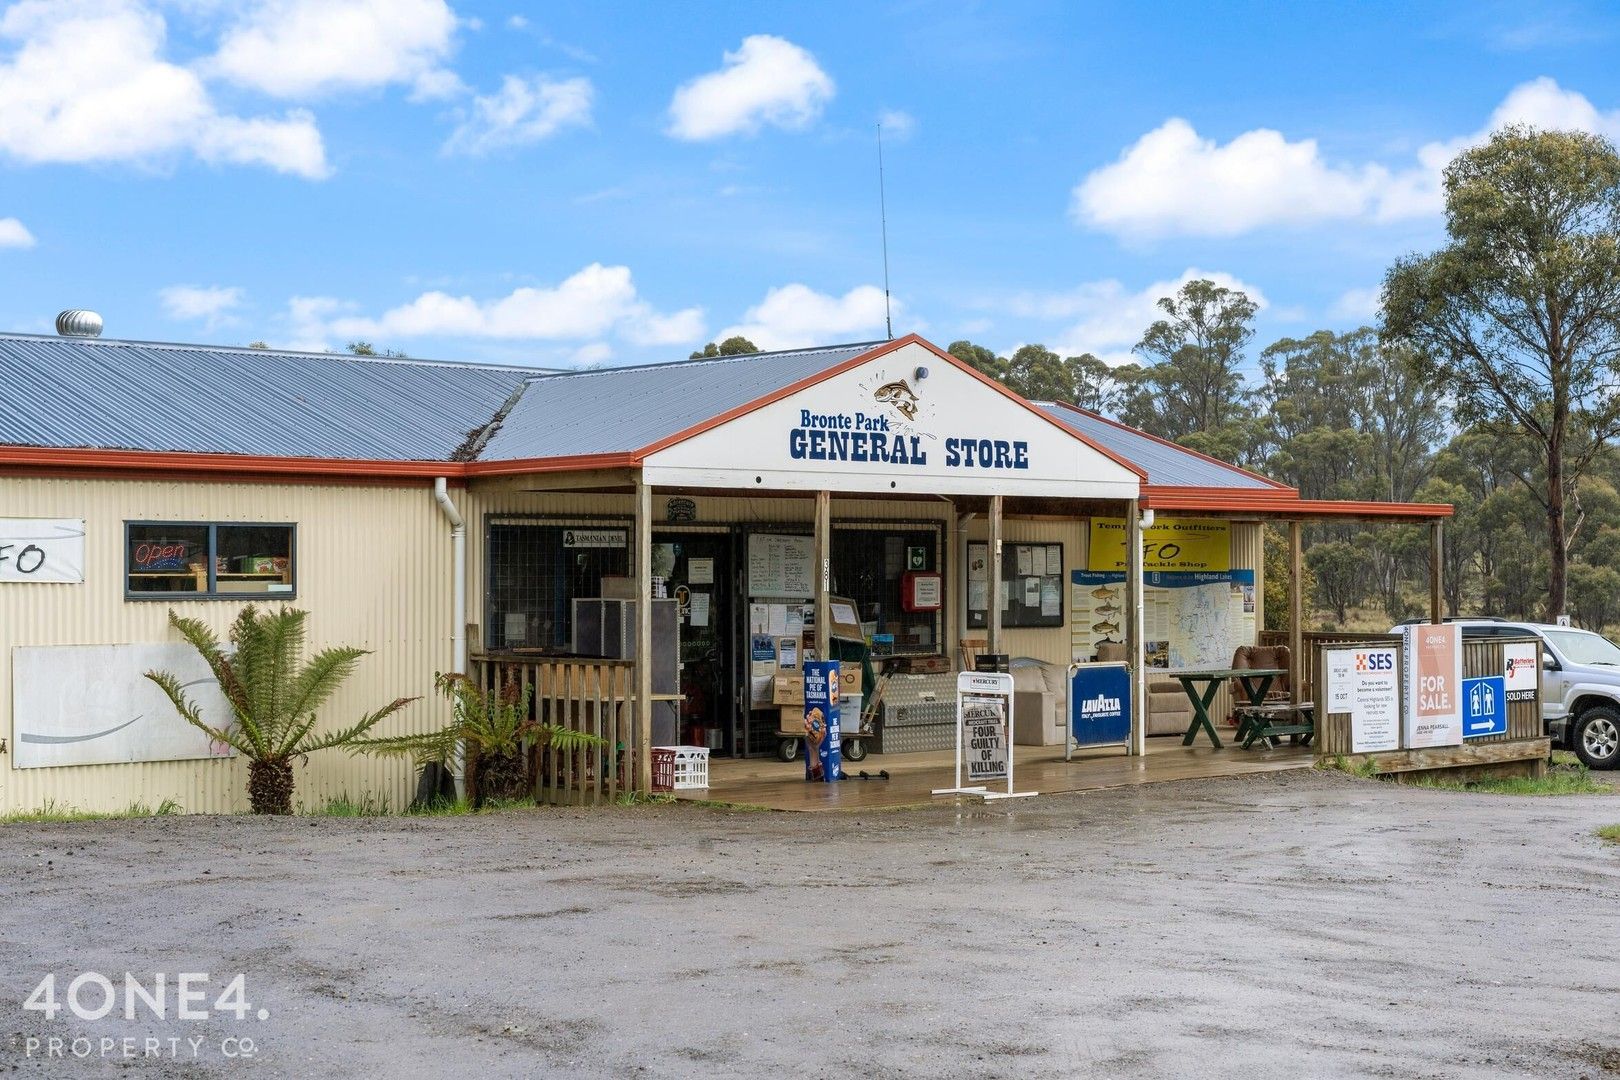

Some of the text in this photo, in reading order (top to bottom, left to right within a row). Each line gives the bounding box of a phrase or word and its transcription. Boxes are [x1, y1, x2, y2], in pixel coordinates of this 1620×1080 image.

[801, 409, 890, 432] Bronte Park
[790, 428, 1029, 469] GENERAL STORE
[135, 543, 185, 565] Open
[1194, 572, 1219, 581] Highland
[1368, 653, 1393, 670] SES
[811, 668, 820, 677] THE
[806, 676, 826, 685] NATIONAL
[1420, 676, 1444, 693] FOR
[806, 690, 827, 699] TASMANIA
[809, 684, 817, 692] PIE
[1420, 693, 1452, 711] SALE.
[1506, 691, 1535, 701] SOLD HERE
[1081, 694, 1121, 713] LAVAZZA
[972, 725, 996, 738] FOUR
[970, 737, 1000, 750] GUILTY
[980, 749, 993, 761] OF
[971, 761, 1005, 774] KILLING
